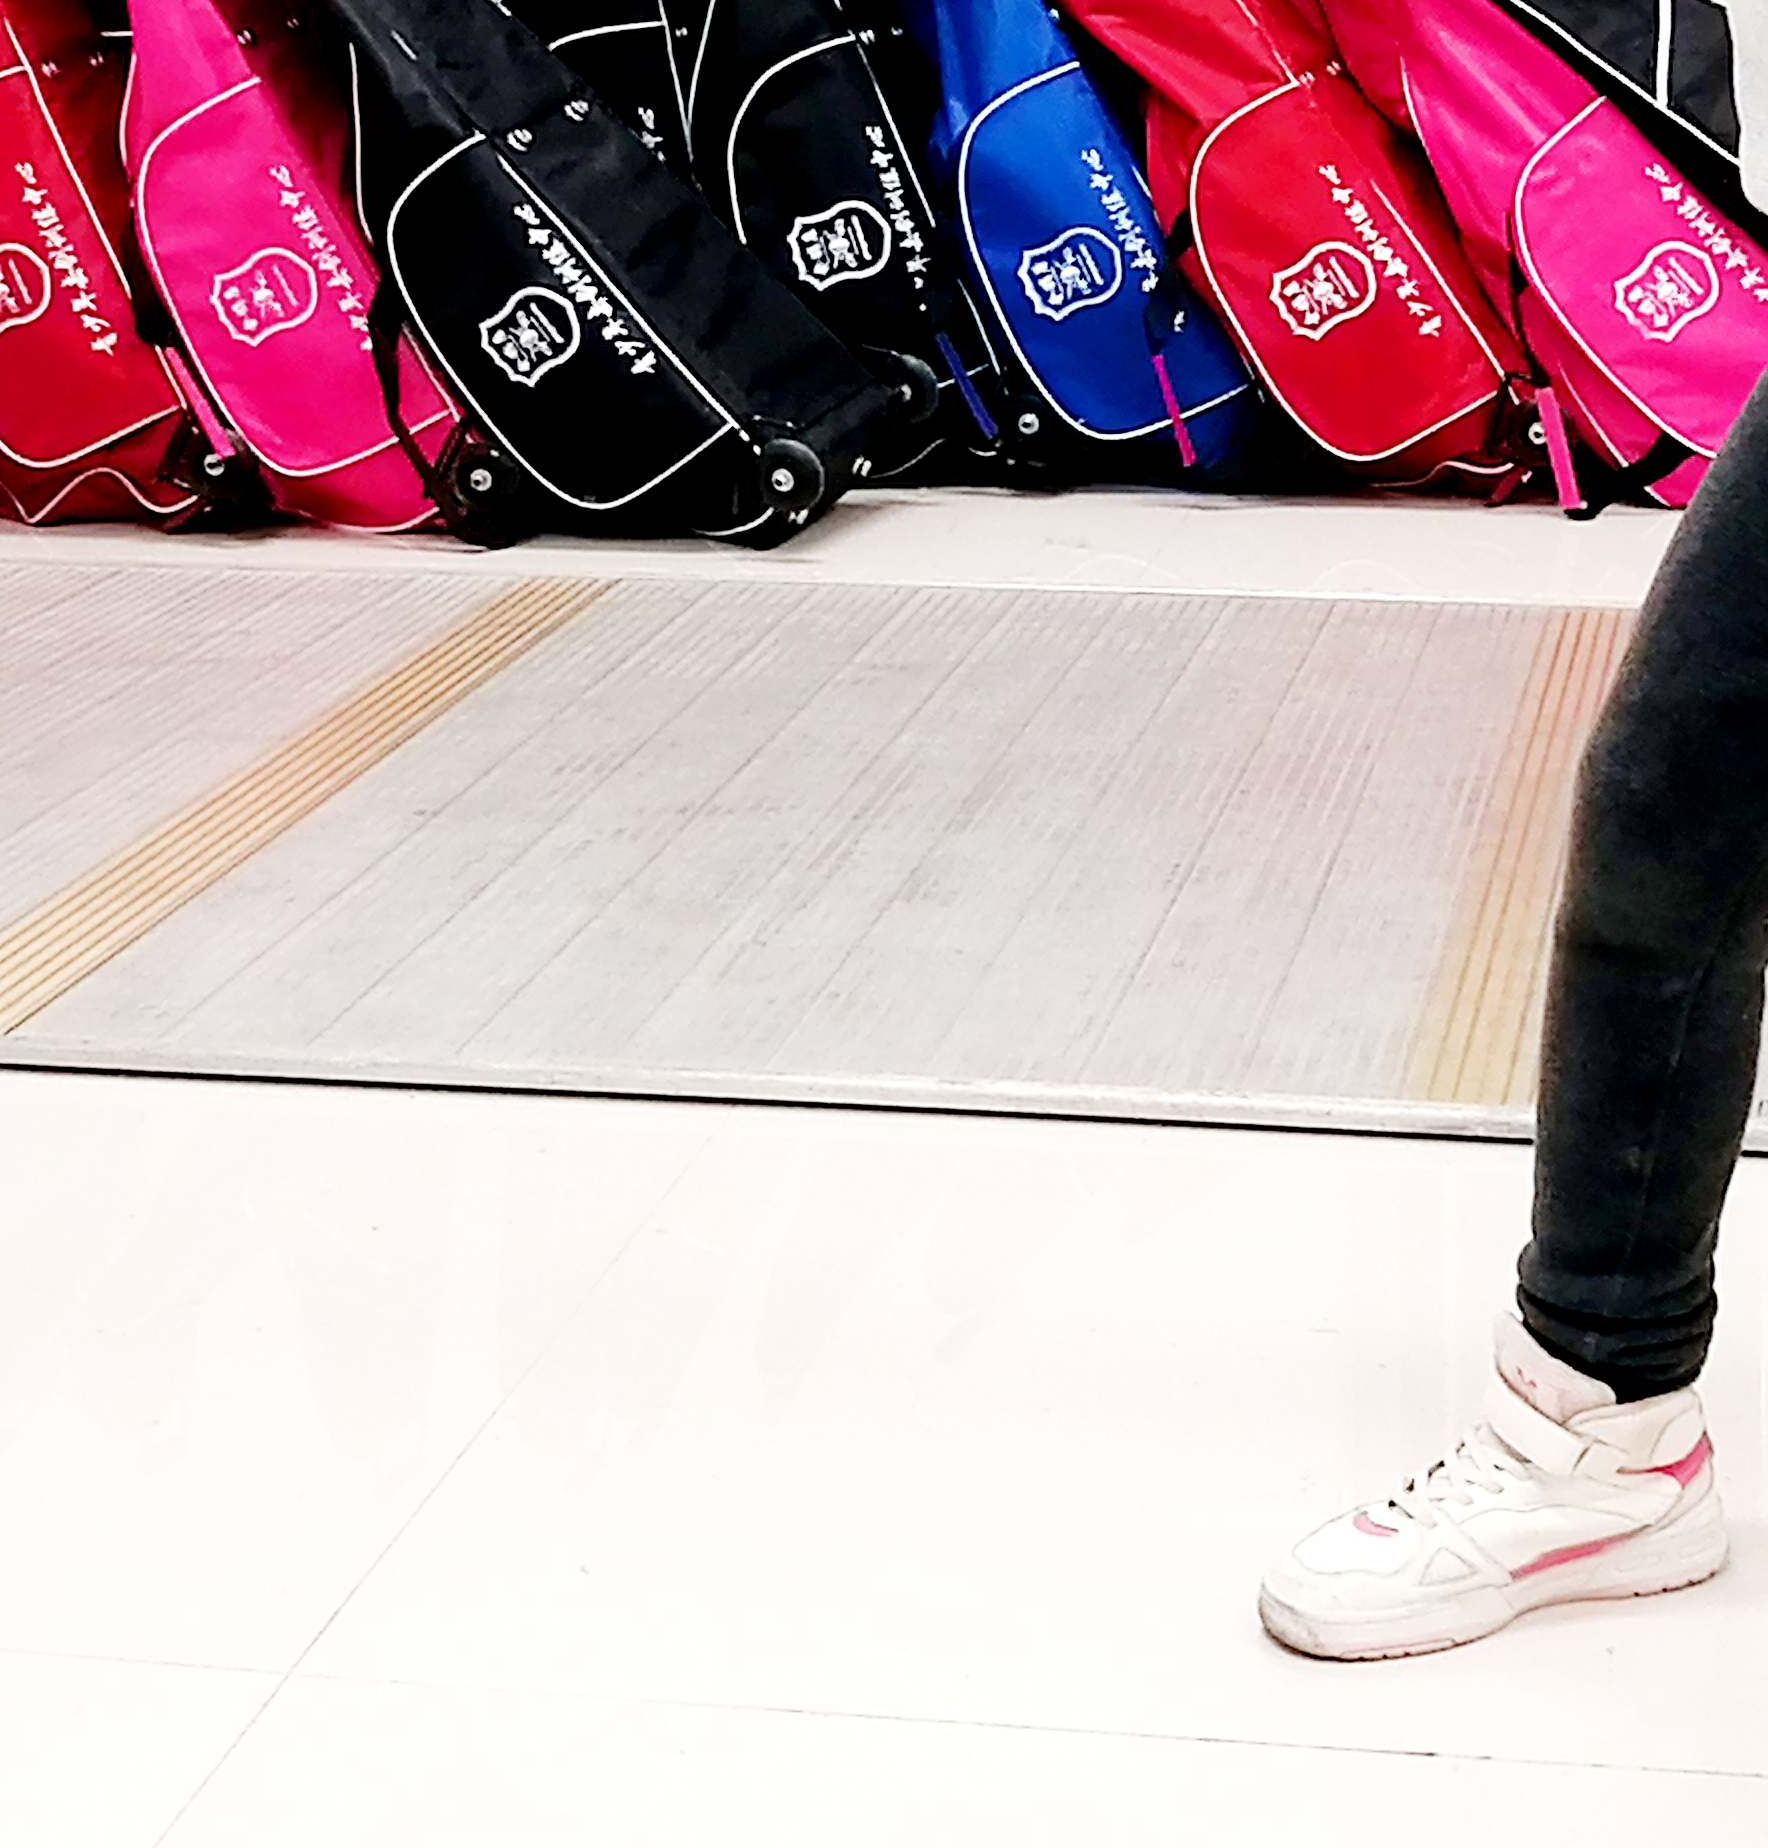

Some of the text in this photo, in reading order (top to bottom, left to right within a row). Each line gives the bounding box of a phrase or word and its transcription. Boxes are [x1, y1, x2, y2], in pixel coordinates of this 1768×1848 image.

[14, 161, 118, 356] 青少年击剑训练中心
[512, 202, 658, 376] 青少年击剑训练中心
[1317, 163, 1443, 338] 青少年击剑训练中心
